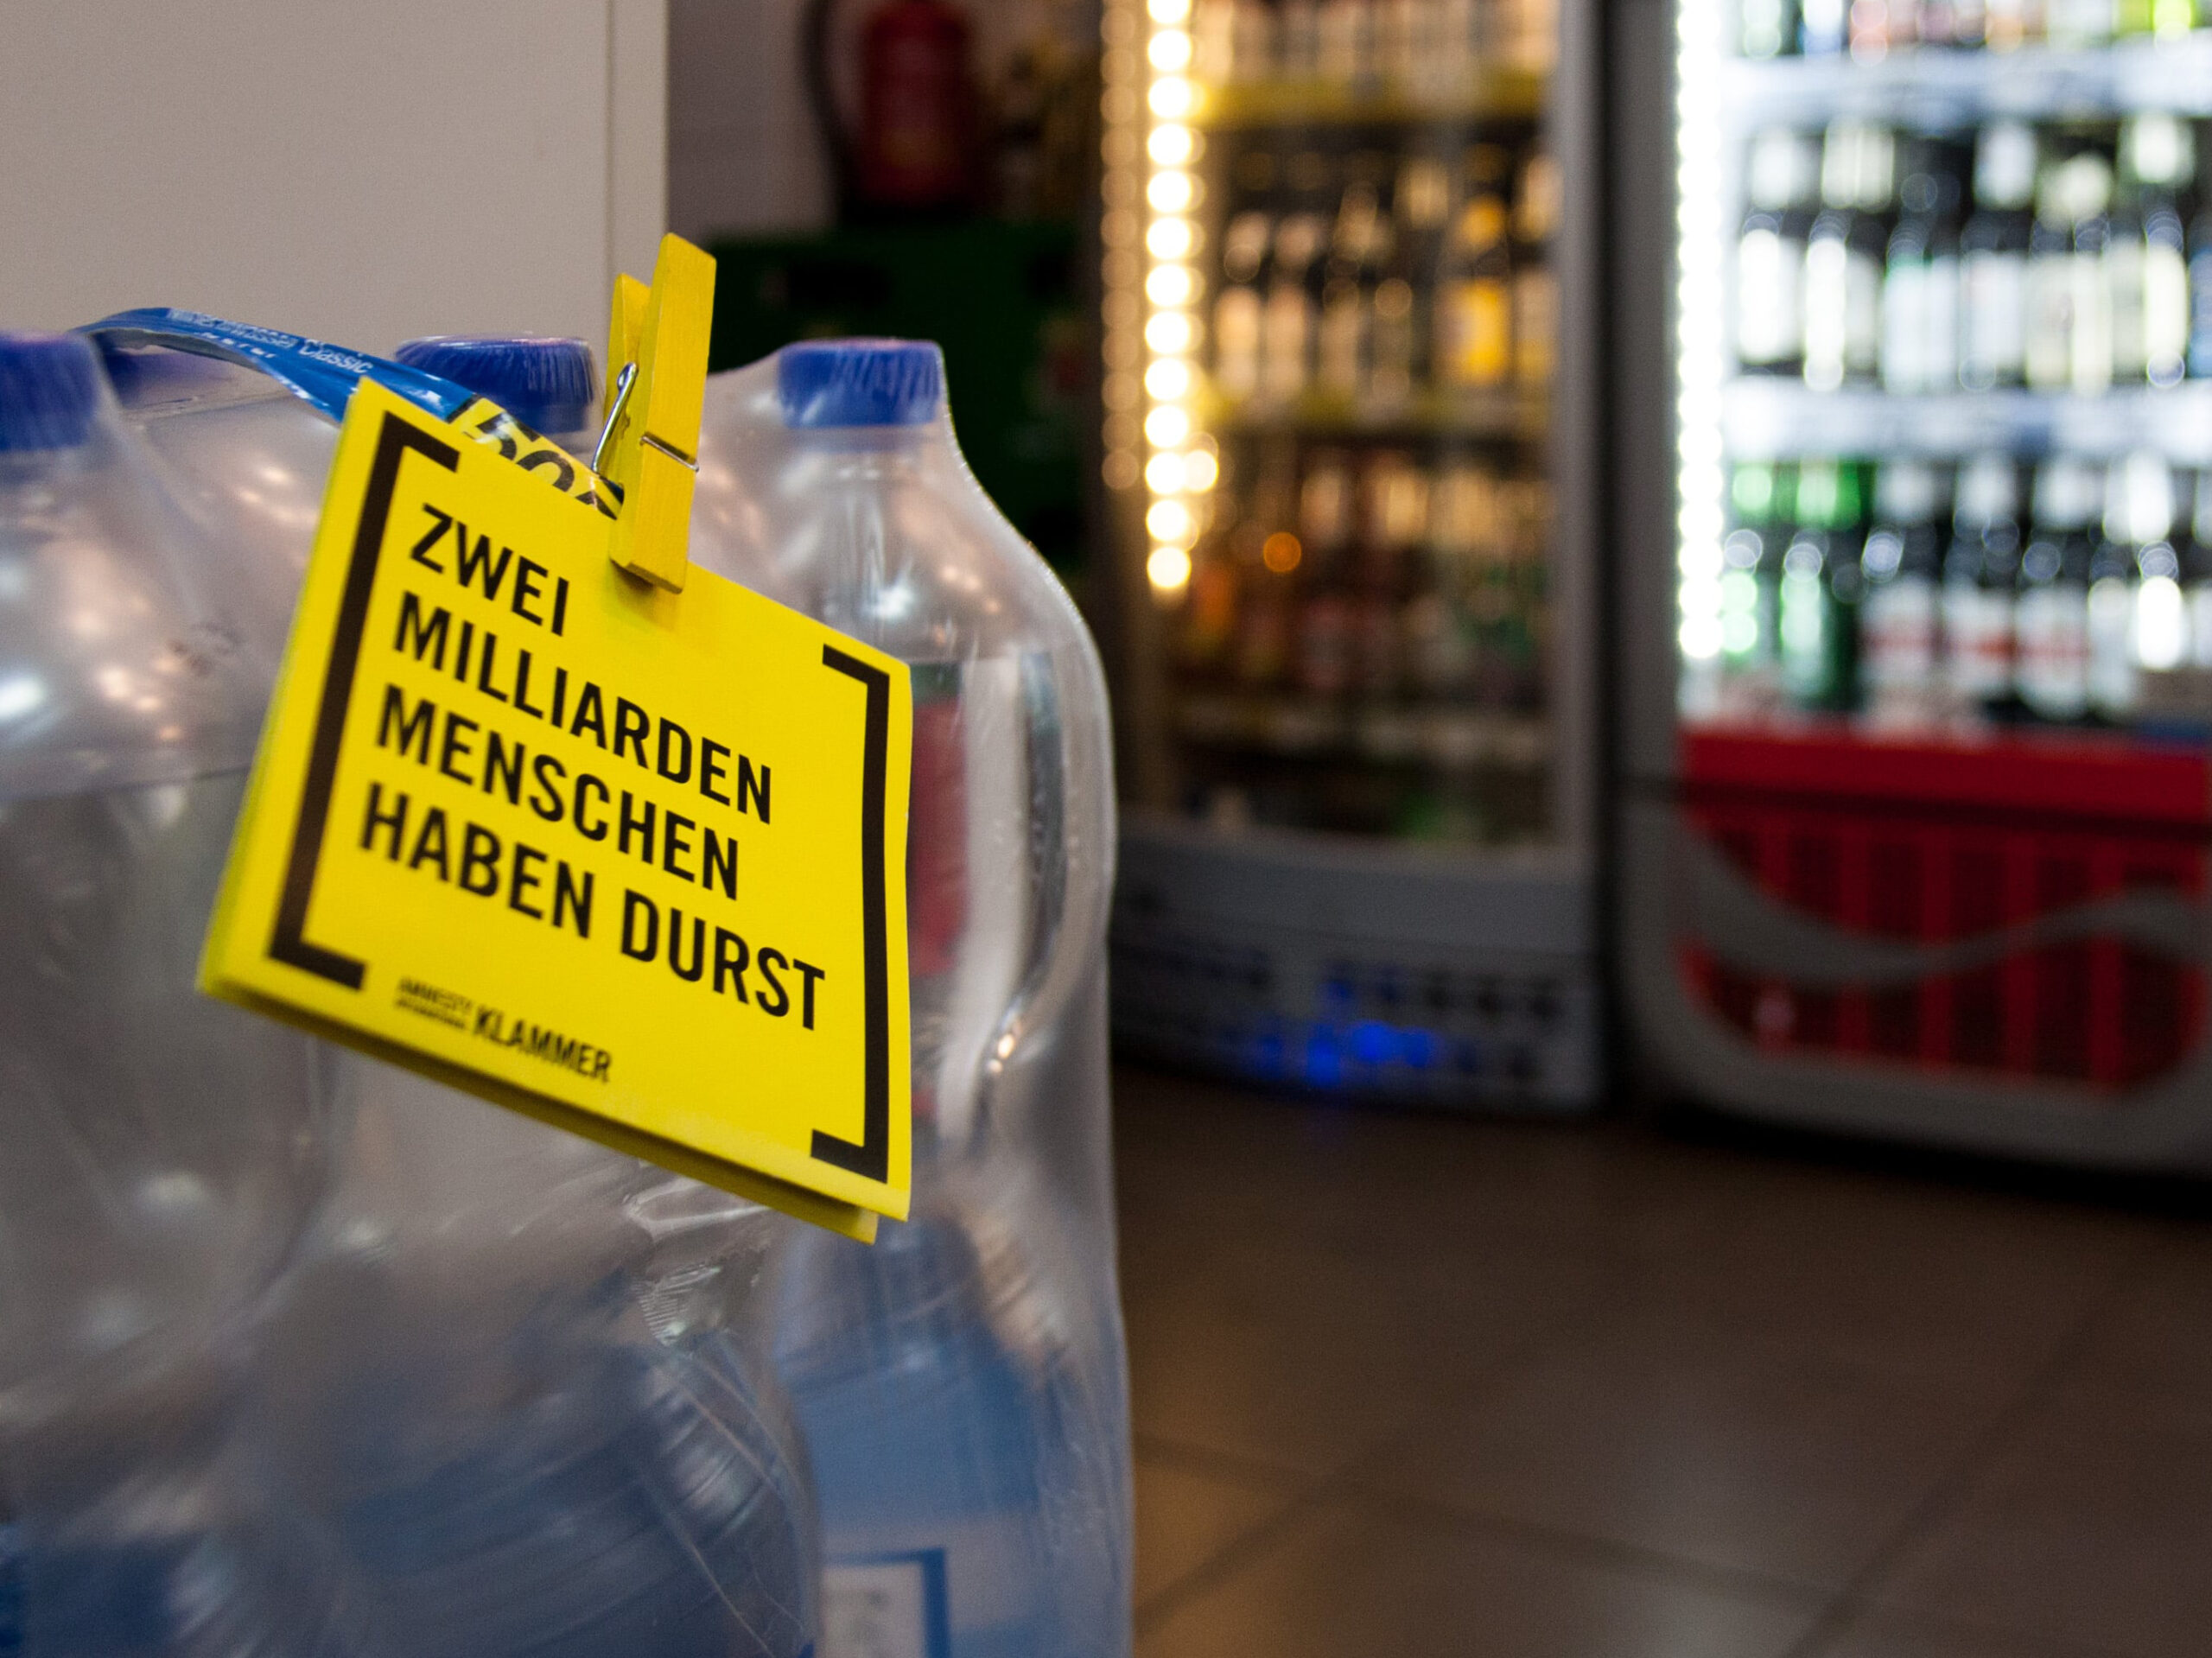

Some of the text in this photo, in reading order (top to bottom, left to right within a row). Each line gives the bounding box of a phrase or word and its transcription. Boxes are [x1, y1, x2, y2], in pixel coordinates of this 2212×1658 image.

[410, 503, 569, 638] ZWEI
[377, 683, 739, 901] MENSCHEN
[392, 590, 772, 826] MILLIARDEN
[359, 781, 827, 1032] HABEN DURST
[474, 1005, 612, 1083] KLAMMER
